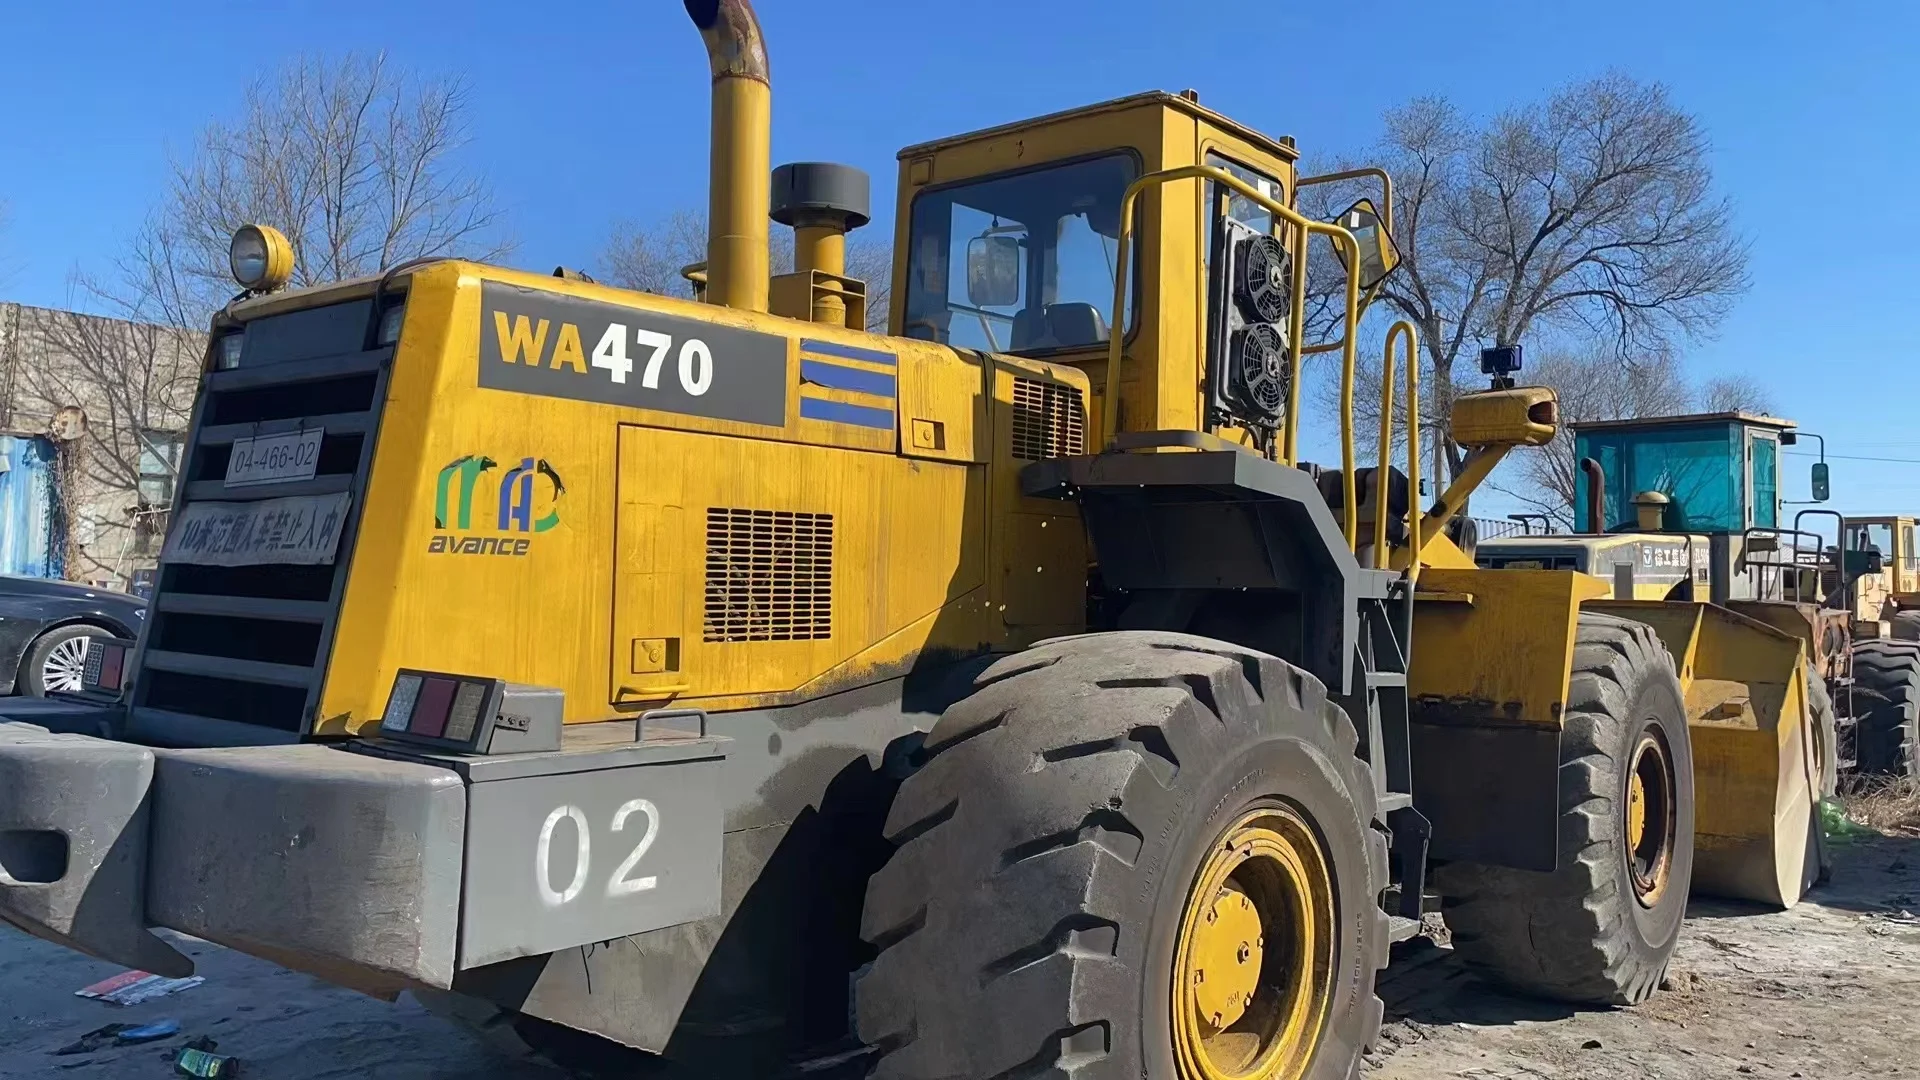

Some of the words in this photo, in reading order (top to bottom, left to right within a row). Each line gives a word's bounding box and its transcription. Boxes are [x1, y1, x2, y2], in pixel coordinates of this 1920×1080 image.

[494, 311, 713, 396] WA470
[234, 441, 316, 473] 04-466-02
[428, 535, 530, 556] avance
[536, 798, 660, 904] 02
